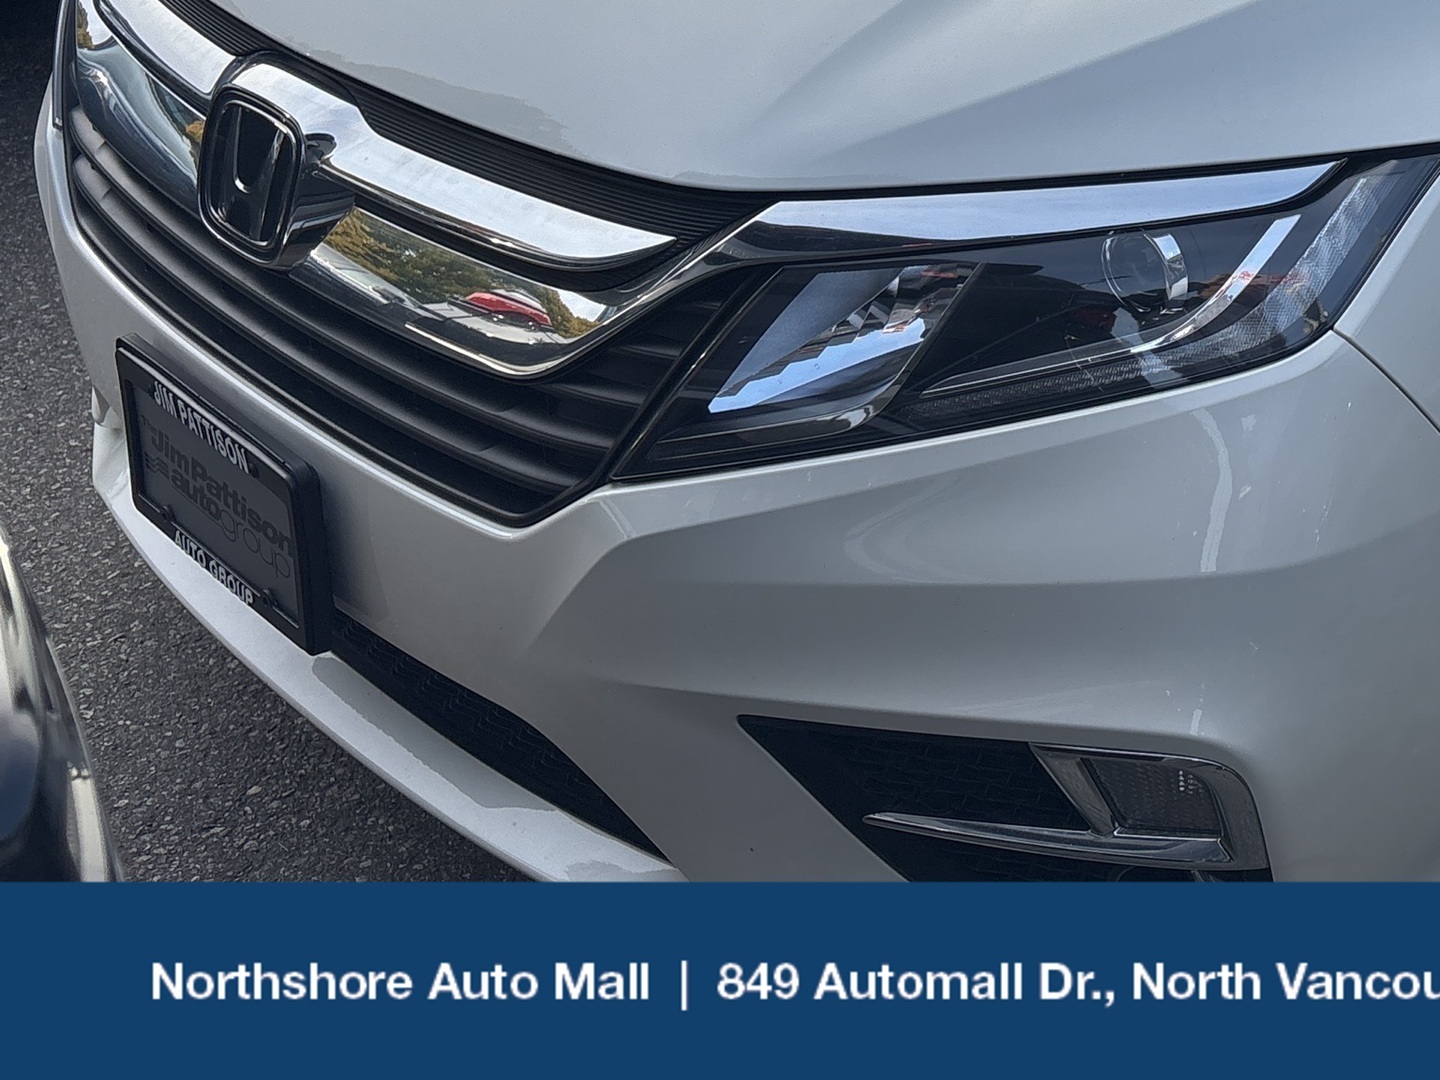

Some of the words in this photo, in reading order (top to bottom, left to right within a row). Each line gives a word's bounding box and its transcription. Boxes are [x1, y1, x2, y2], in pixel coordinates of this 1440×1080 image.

[153, 380, 178, 419] JIM
[177, 399, 250, 475] PATTISON
[174, 529, 207, 569] AUTO
[209, 559, 254, 605] GROUP
